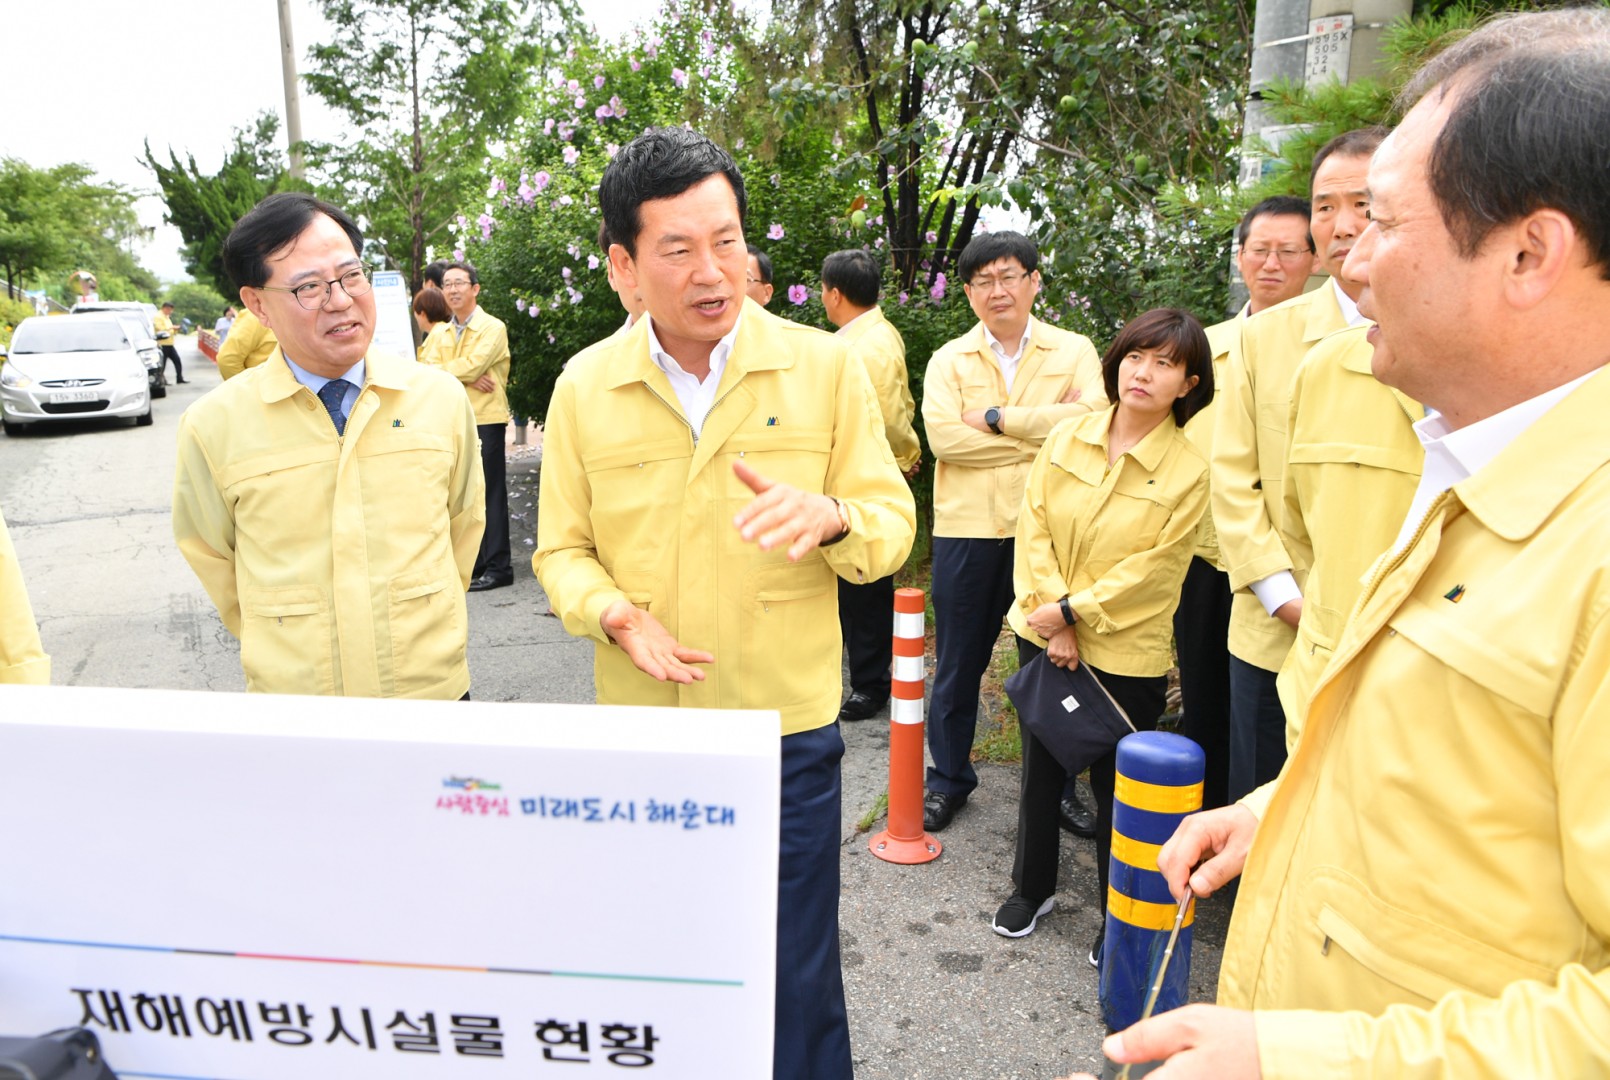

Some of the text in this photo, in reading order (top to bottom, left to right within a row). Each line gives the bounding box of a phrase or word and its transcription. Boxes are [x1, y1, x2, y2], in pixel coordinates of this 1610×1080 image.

[1314, 55, 1328, 65] 32
[1315, 43, 1337, 54] 505
[519, 795, 636, 823] 미래도시
[645, 799, 736, 830] 해운대
[70, 988, 660, 1068] 재해예방시설물 현황
